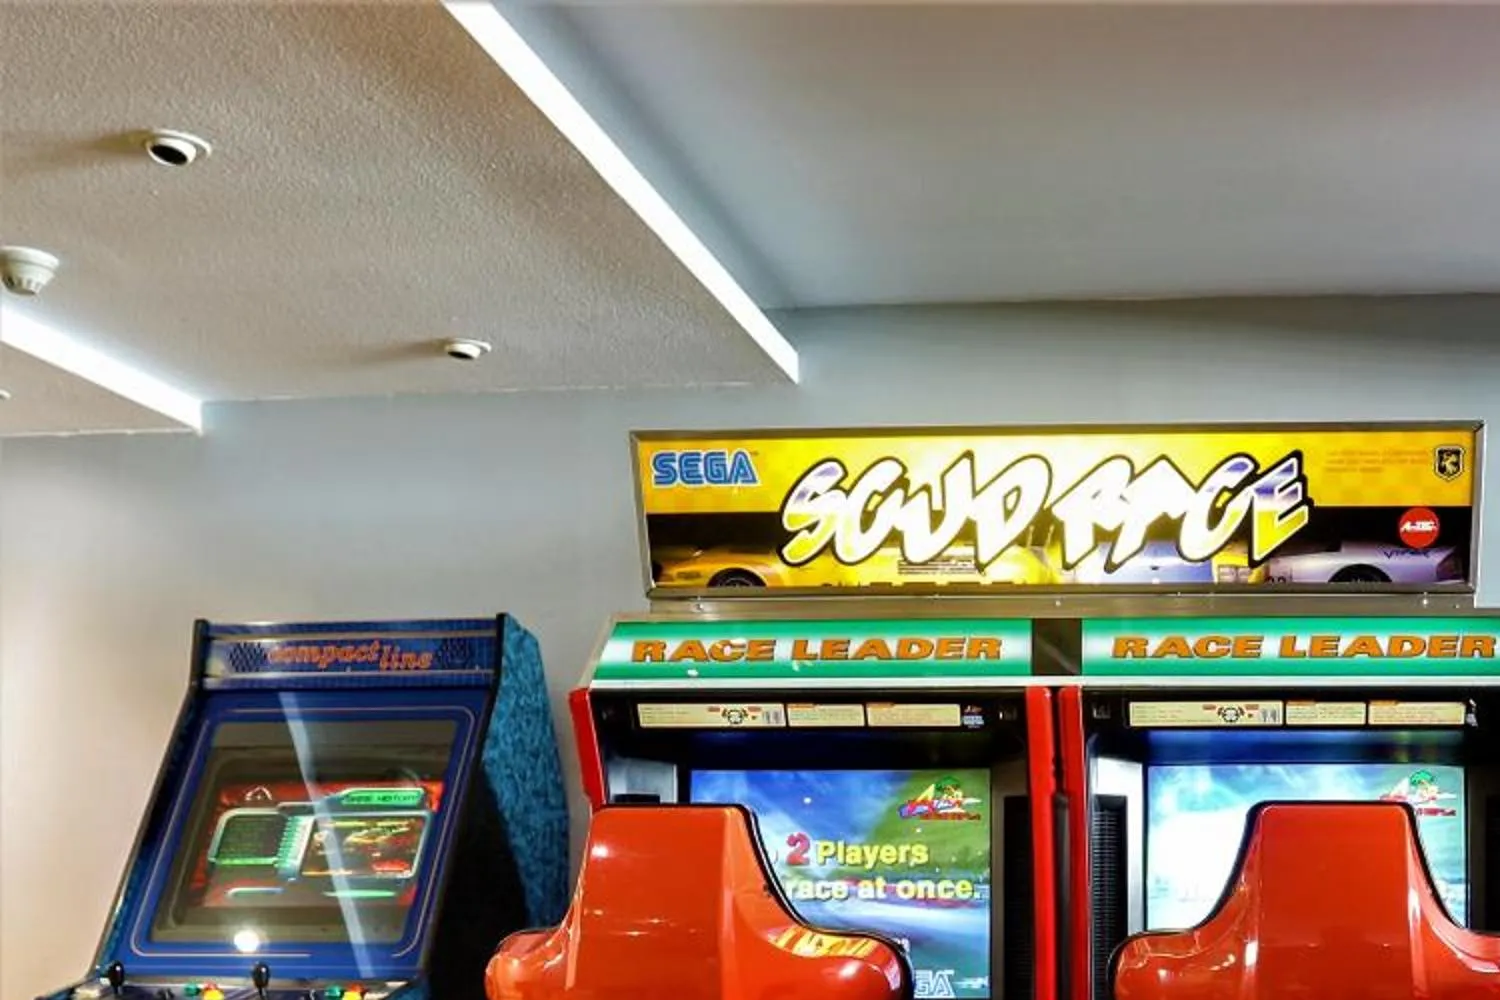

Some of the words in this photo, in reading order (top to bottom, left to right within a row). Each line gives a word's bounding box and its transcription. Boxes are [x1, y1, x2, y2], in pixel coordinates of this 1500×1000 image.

[652, 451, 758, 486] SEGA
[779, 449, 1051, 575] SCUD
[1050, 449, 1314, 572] RACE
[266, 639, 381, 668] compact
[379, 645, 434, 670] line
[631, 638, 777, 663] RACE
[791, 637, 1003, 662] LEADER
[1111, 635, 1264, 659] RACE
[1279, 634, 1497, 659] LEADER
[786, 832, 811, 866] 2
[816, 839, 930, 869] Players
[787, 877, 850, 900] race
[857, 877, 887, 900] at
[896, 878, 981, 900] once.
